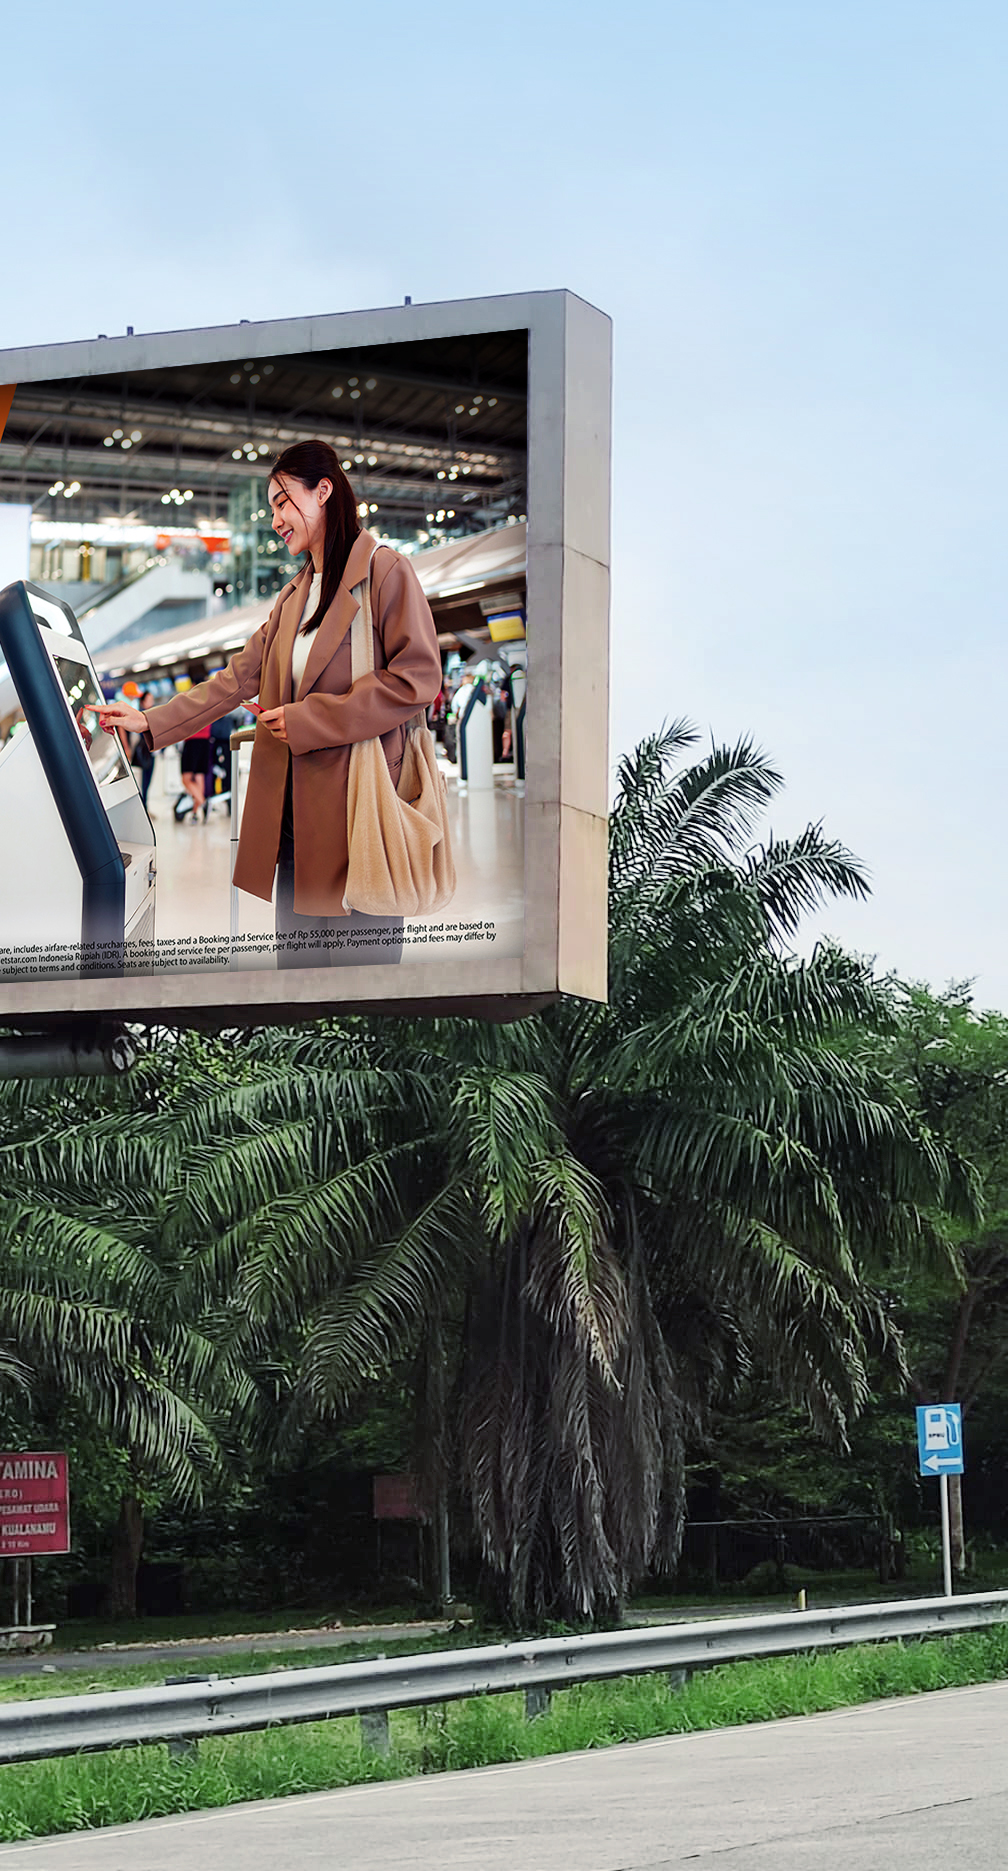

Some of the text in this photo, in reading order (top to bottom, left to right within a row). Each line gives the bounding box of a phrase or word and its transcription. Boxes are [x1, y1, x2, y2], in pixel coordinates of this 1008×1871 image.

[13, 944, 43, 954] includes
[44, 941, 95, 952] airfare-related
[96, 940, 137, 950] surcharges,
[138, 938, 155, 948] fees,
[176, 936, 191, 945] and
[199, 934, 230, 945] Booking
[231, 933, 246, 942] and
[247, 931, 274, 942] Service
[275, 931, 287, 940] fee
[288, 930, 298, 939] of
[298, 930, 309, 940] Rp
[309, 929, 335, 940] 55,000
[336, 929, 349, 939] per
[350, 927, 391, 937] passenger,
[392, 926, 406, 935] per
[407, 923, 427, 934] flight
[428, 923, 444, 932] and
[459, 921, 482, 931] based
[38, 953, 74, 963] Indonesia
[75, 951, 100, 961] Rupiah
[101, 950, 122, 960] (IDR).
[129, 947, 160, 958] booking
[161, 947, 176, 956] and
[177, 946, 203, 955] service
[204, 945, 216, 954] fee
[217, 946, 230, 954] per
[231, 944, 272, 954] passenger,
[272, 943, 285, 952] per
[286, 941, 307, 951] flight
[307, 939, 321, 948] will
[322, 939, 345, 949] apply.
[347, 937, 380, 948] Payment
[381, 936, 411, 946] options
[412, 934, 427, 943] and
[428, 934, 445, 943] fees
[446, 934, 462, 943] may
[464, 931, 485, 941] differ
[486, 931, 497, 942] by
[2, 965, 28, 975] subject
[38, 964, 60, 972] terms
[60, 963, 75, 971] and
[76, 961, 115, 971] conditions.
[117, 960, 137, 968] Seats
[152, 958, 178, 968] subject
[179, 958, 187, 966] to
[189, 956, 230, 966] availability.
[34, 1502, 59, 1513] UDARA
[2, 1522, 56, 1536] KUALANAMU
